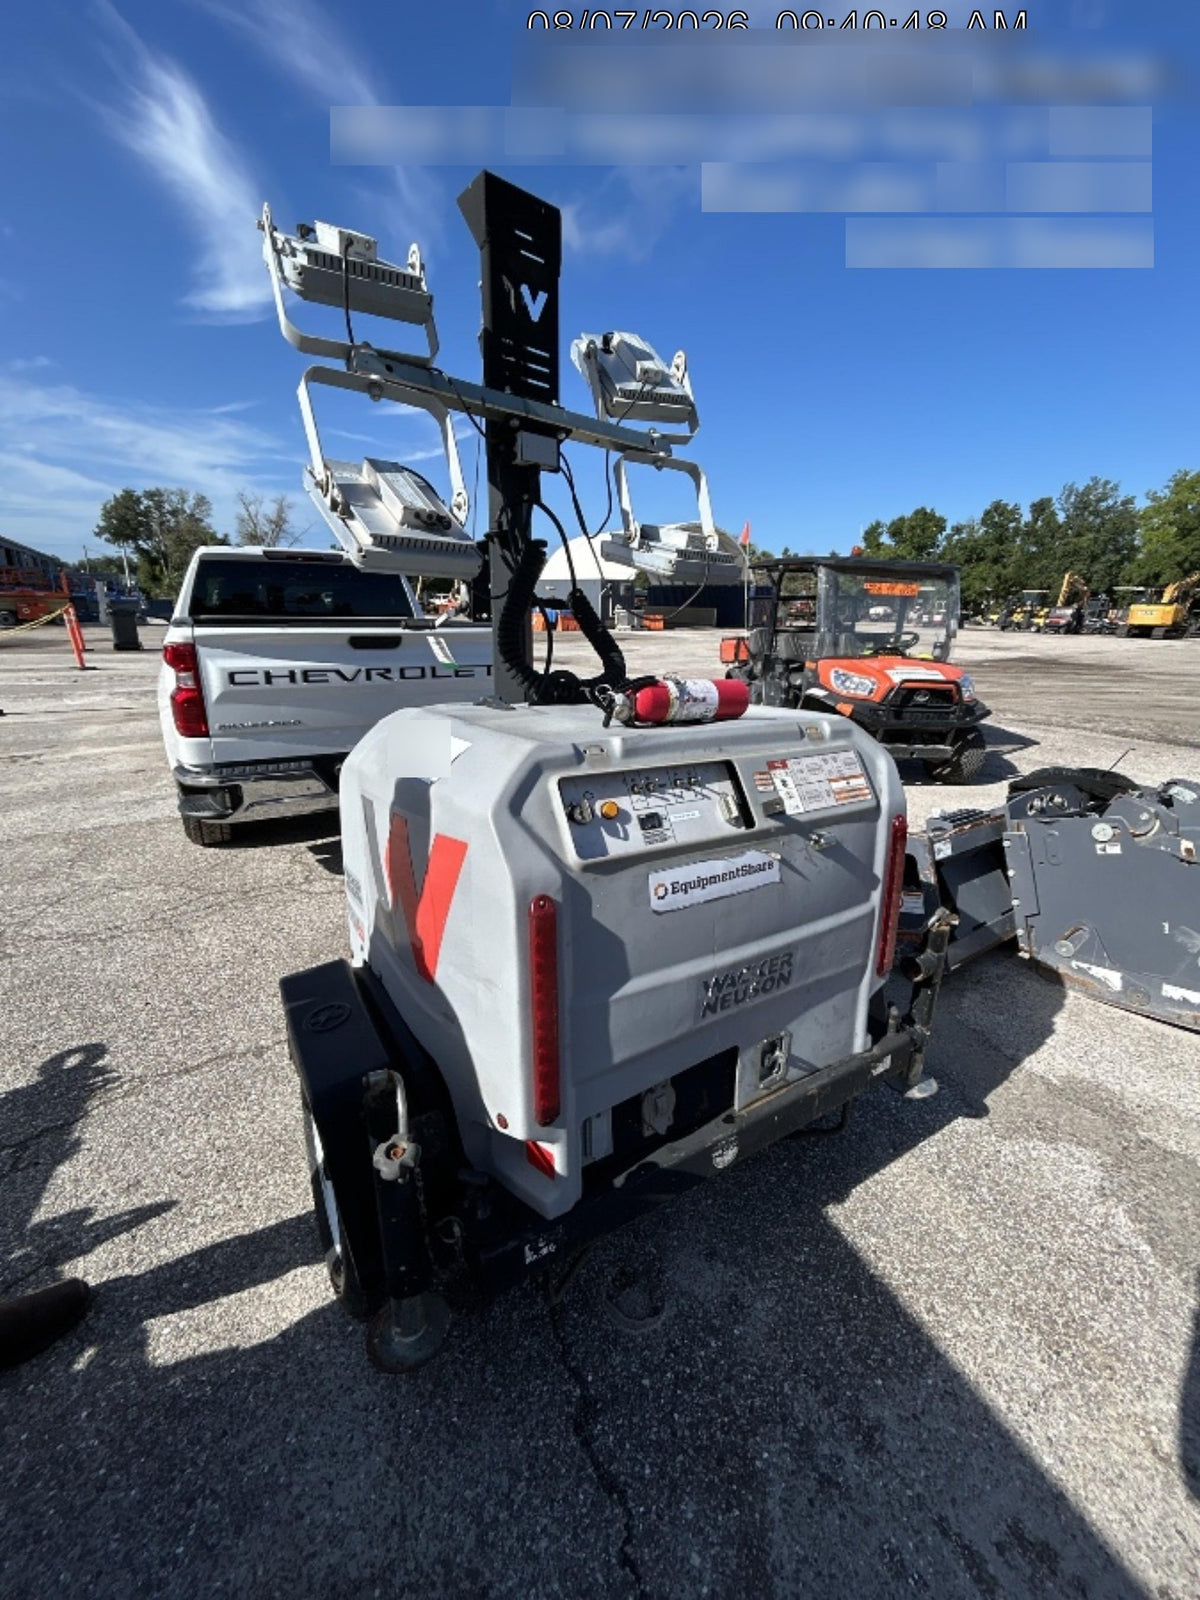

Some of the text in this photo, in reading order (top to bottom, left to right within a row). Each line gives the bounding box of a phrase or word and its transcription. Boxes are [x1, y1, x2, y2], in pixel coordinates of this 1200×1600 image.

[228, 664, 492, 686] CHEVROLET
[670, 860, 774, 895] EquipmentShare
[701, 969, 793, 1019] NEUSON
[702, 952, 794, 998] WACKER
